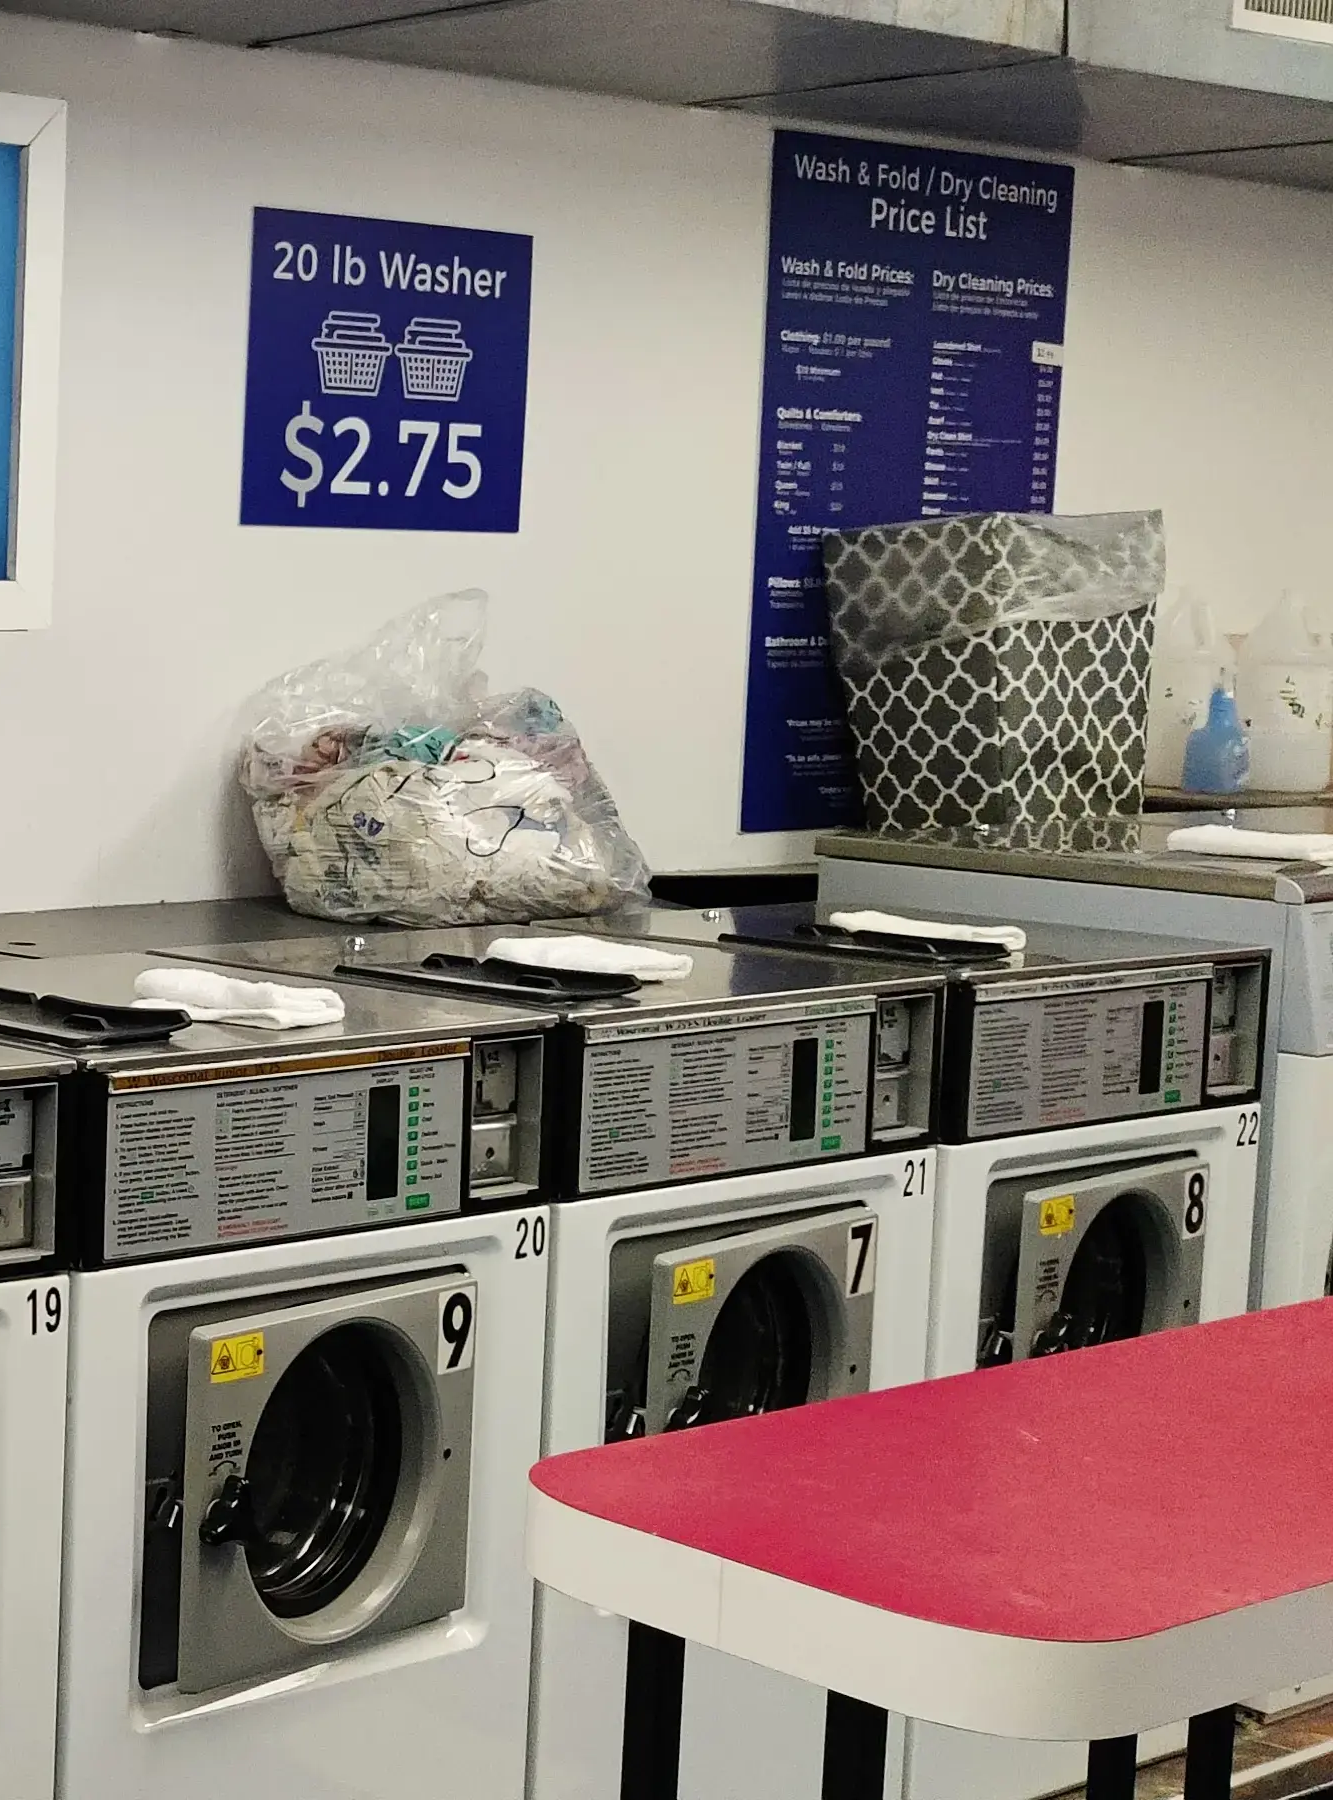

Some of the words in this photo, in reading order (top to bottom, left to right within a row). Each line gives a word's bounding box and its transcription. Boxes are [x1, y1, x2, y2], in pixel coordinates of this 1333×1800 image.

[794, 153, 850, 184] Wash
[857, 161, 870, 186] &
[878, 164, 920, 192] Fold
[925, 167, 936, 196] /
[940, 172, 974, 202] Dry
[979, 176, 1058, 213] Cleaning
[870, 197, 935, 234] Price
[945, 206, 988, 240] List
[273, 241, 318, 281] 20
[333, 244, 366, 286] lb
[379, 250, 507, 298] Washer
[781, 256, 820, 276] Wash
[823, 261, 833, 277] &
[837, 261, 867, 280] Fold
[871, 265, 914, 284] Prices:
[933, 270, 954, 291] Dry
[958, 272, 1013, 298] Cleaning
[1017, 278, 1055, 298] Prices:
[280, 400, 482, 507] $2.75
[148, 1067, 208, 1086] Wascomat
[1236, 1110, 1258, 1147] 22
[902, 1157, 927, 1197] 21
[1184, 1172, 1205, 1233] 8
[515, 1216, 546, 1260] 20
[850, 1222, 873, 1296] 7
[26, 1286, 62, 1335] 19
[442, 1292, 472, 1370] 9
